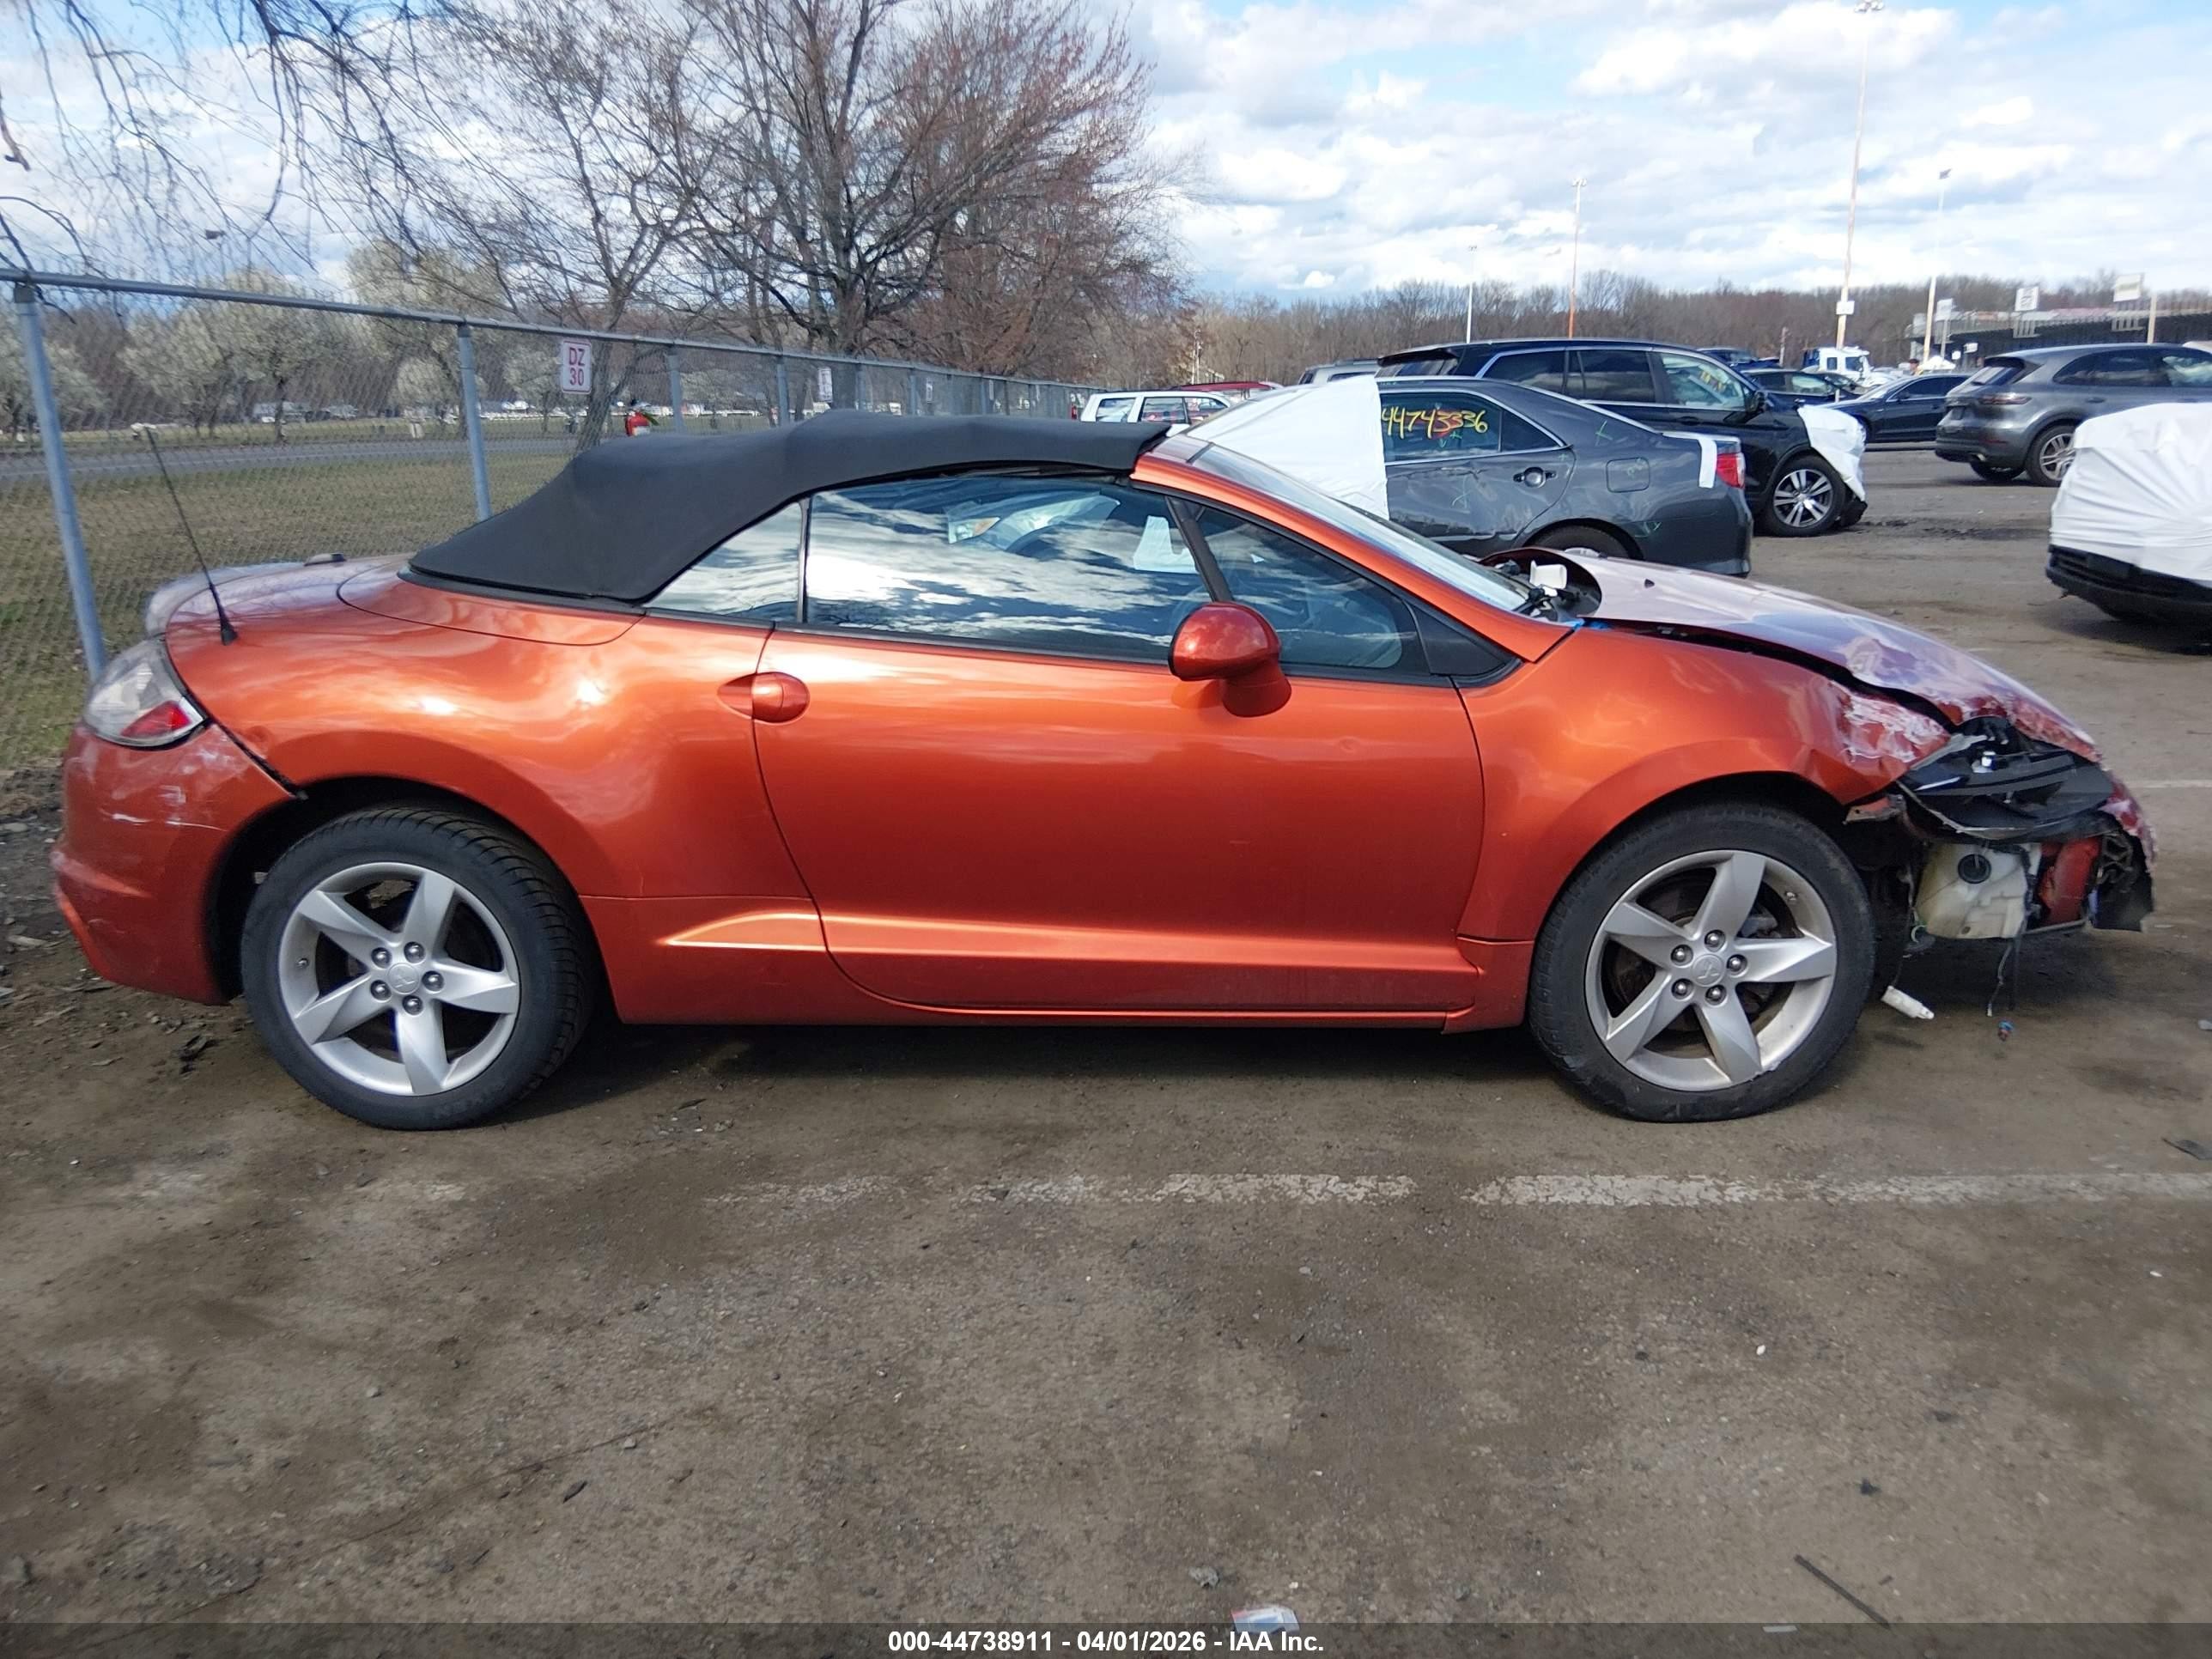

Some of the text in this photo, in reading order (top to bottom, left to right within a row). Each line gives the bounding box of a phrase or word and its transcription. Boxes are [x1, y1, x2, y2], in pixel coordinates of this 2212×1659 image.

[568, 347, 586, 366] DZ
[569, 368, 585, 386] 30
[1381, 406, 1488, 440] 44743336
